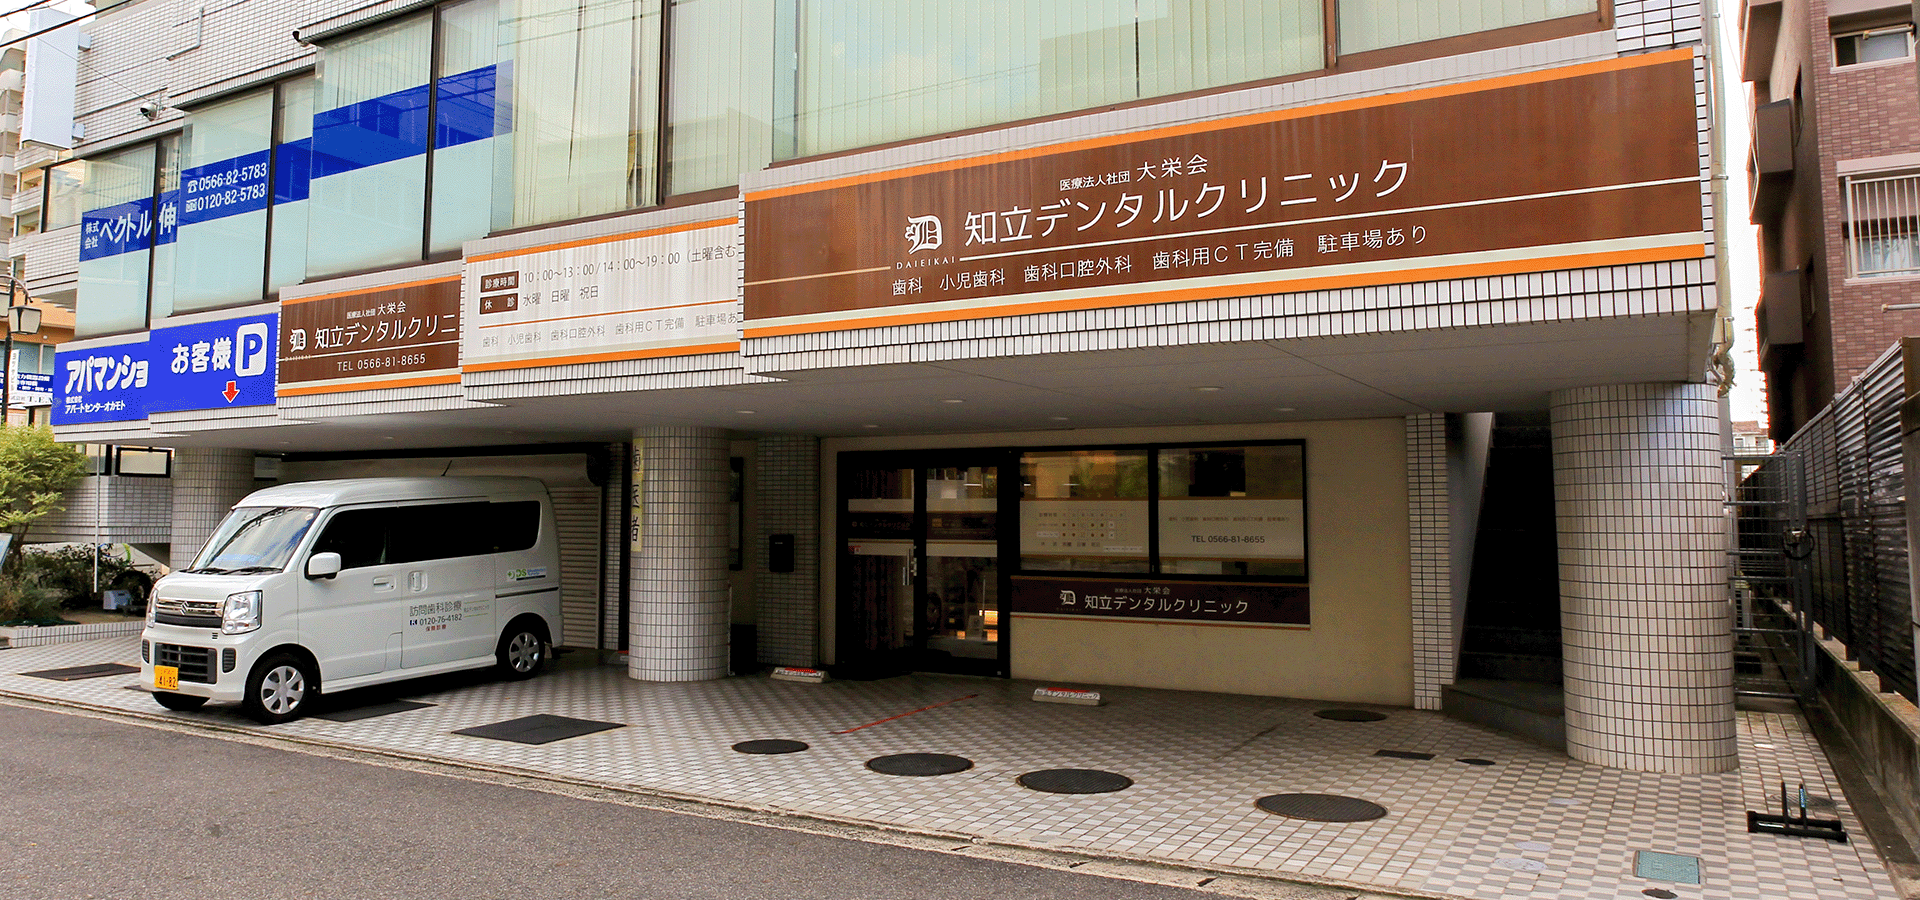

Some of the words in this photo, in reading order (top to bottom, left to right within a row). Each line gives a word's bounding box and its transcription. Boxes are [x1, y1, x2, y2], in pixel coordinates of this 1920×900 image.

[198, 162, 267, 192] 0566-82-5783
[1059, 170, 1130, 191] 医療法人社団
[1136, 153, 1208, 182] 大栄会
[197, 183, 266, 211] 0120-82-5783
[964, 159, 1408, 247] 知立デンタルクリニック
[892, 277, 923, 296] 歯科
[939, 269, 1006, 292] 小児歯科
[1023, 255, 1132, 284] 歯科口腔外科
[1152, 238, 1294, 271] 歯科用CT完備
[1317, 225, 1427, 254] 駐車場あり
[896, 255, 956, 270] DAIEIKAI
[484, 275, 516, 290] 診療時間
[522, 292, 542, 307] 水曜
[551, 288, 570, 303] 日曜
[579, 285, 599, 300] 祝日
[377, 300, 406, 316] 大栄会
[314, 314, 457, 350] 知立デンタルクリニ
[482, 335, 499, 348] 歯科
[507, 332, 542, 346] 小児歯科
[550, 327, 606, 342] 歯科口腔外科
[171, 336, 233, 374] お客様
[337, 361, 353, 372] TEL
[357, 353, 426, 371] 0566-81-8655
[65, 354, 149, 394] アパマンショ
[65, 399, 126, 415] アパートセンターオカモト
[1191, 535, 1205, 543] TEL
[1208, 535, 1265, 543] 0566-81-8655
[1144, 586, 1171, 596] 大栄会
[409, 600, 462, 617] 訪問歯科診療
[1084, 594, 1249, 615] 知立デンタルクリニック
[419, 613, 463, 626] 0120-76-4182
